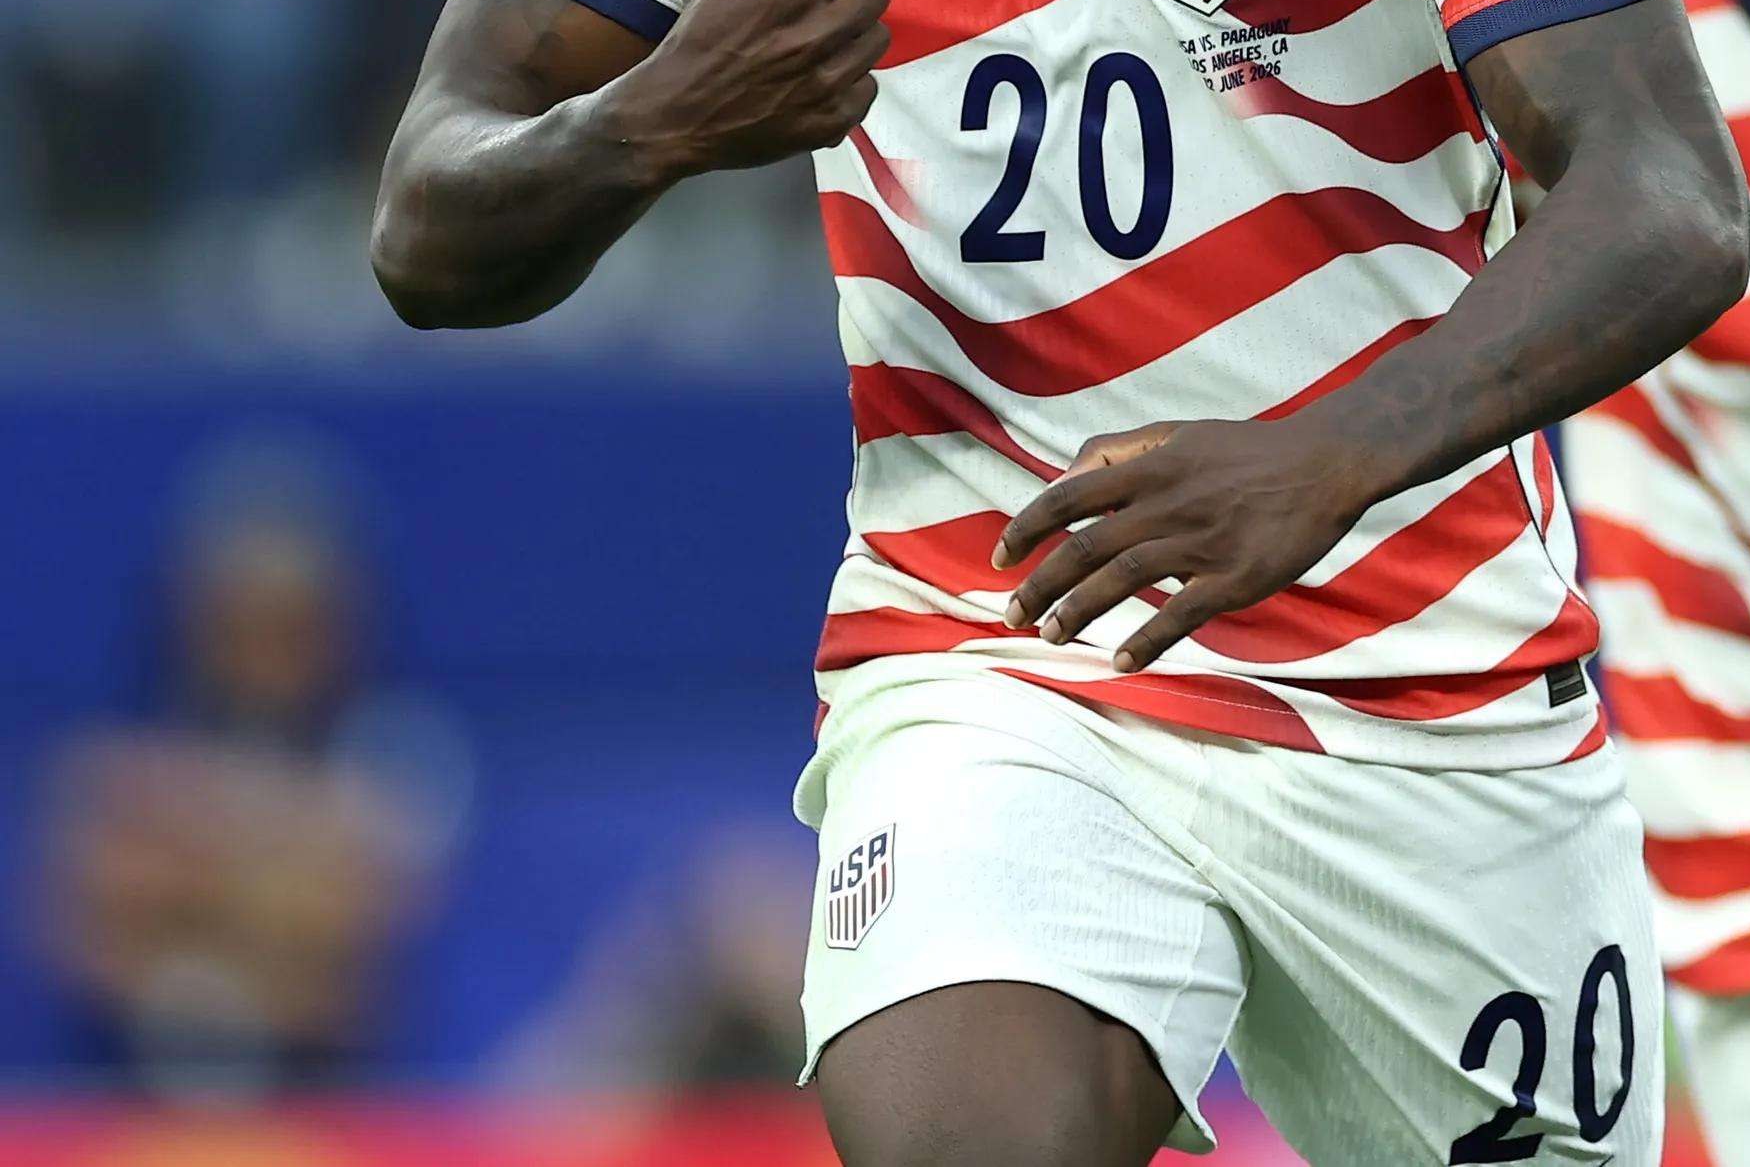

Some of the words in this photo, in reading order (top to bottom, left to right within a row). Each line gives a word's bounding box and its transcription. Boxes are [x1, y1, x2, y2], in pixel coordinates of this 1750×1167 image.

[1179, 40, 1196, 54] SA
[1199, 34, 1216, 52] VS.
[1221, 18, 1291, 46] PARAGUAY
[1212, 45, 1267, 72] ANGELES,
[1272, 38, 1289, 56] CA
[1220, 69, 1245, 93] JUNE
[1250, 61, 1282, 83] 2026
[960, 52, 1174, 263] 20
[831, 833, 888, 893] USA
[1448, 944, 1635, 1166] 20
